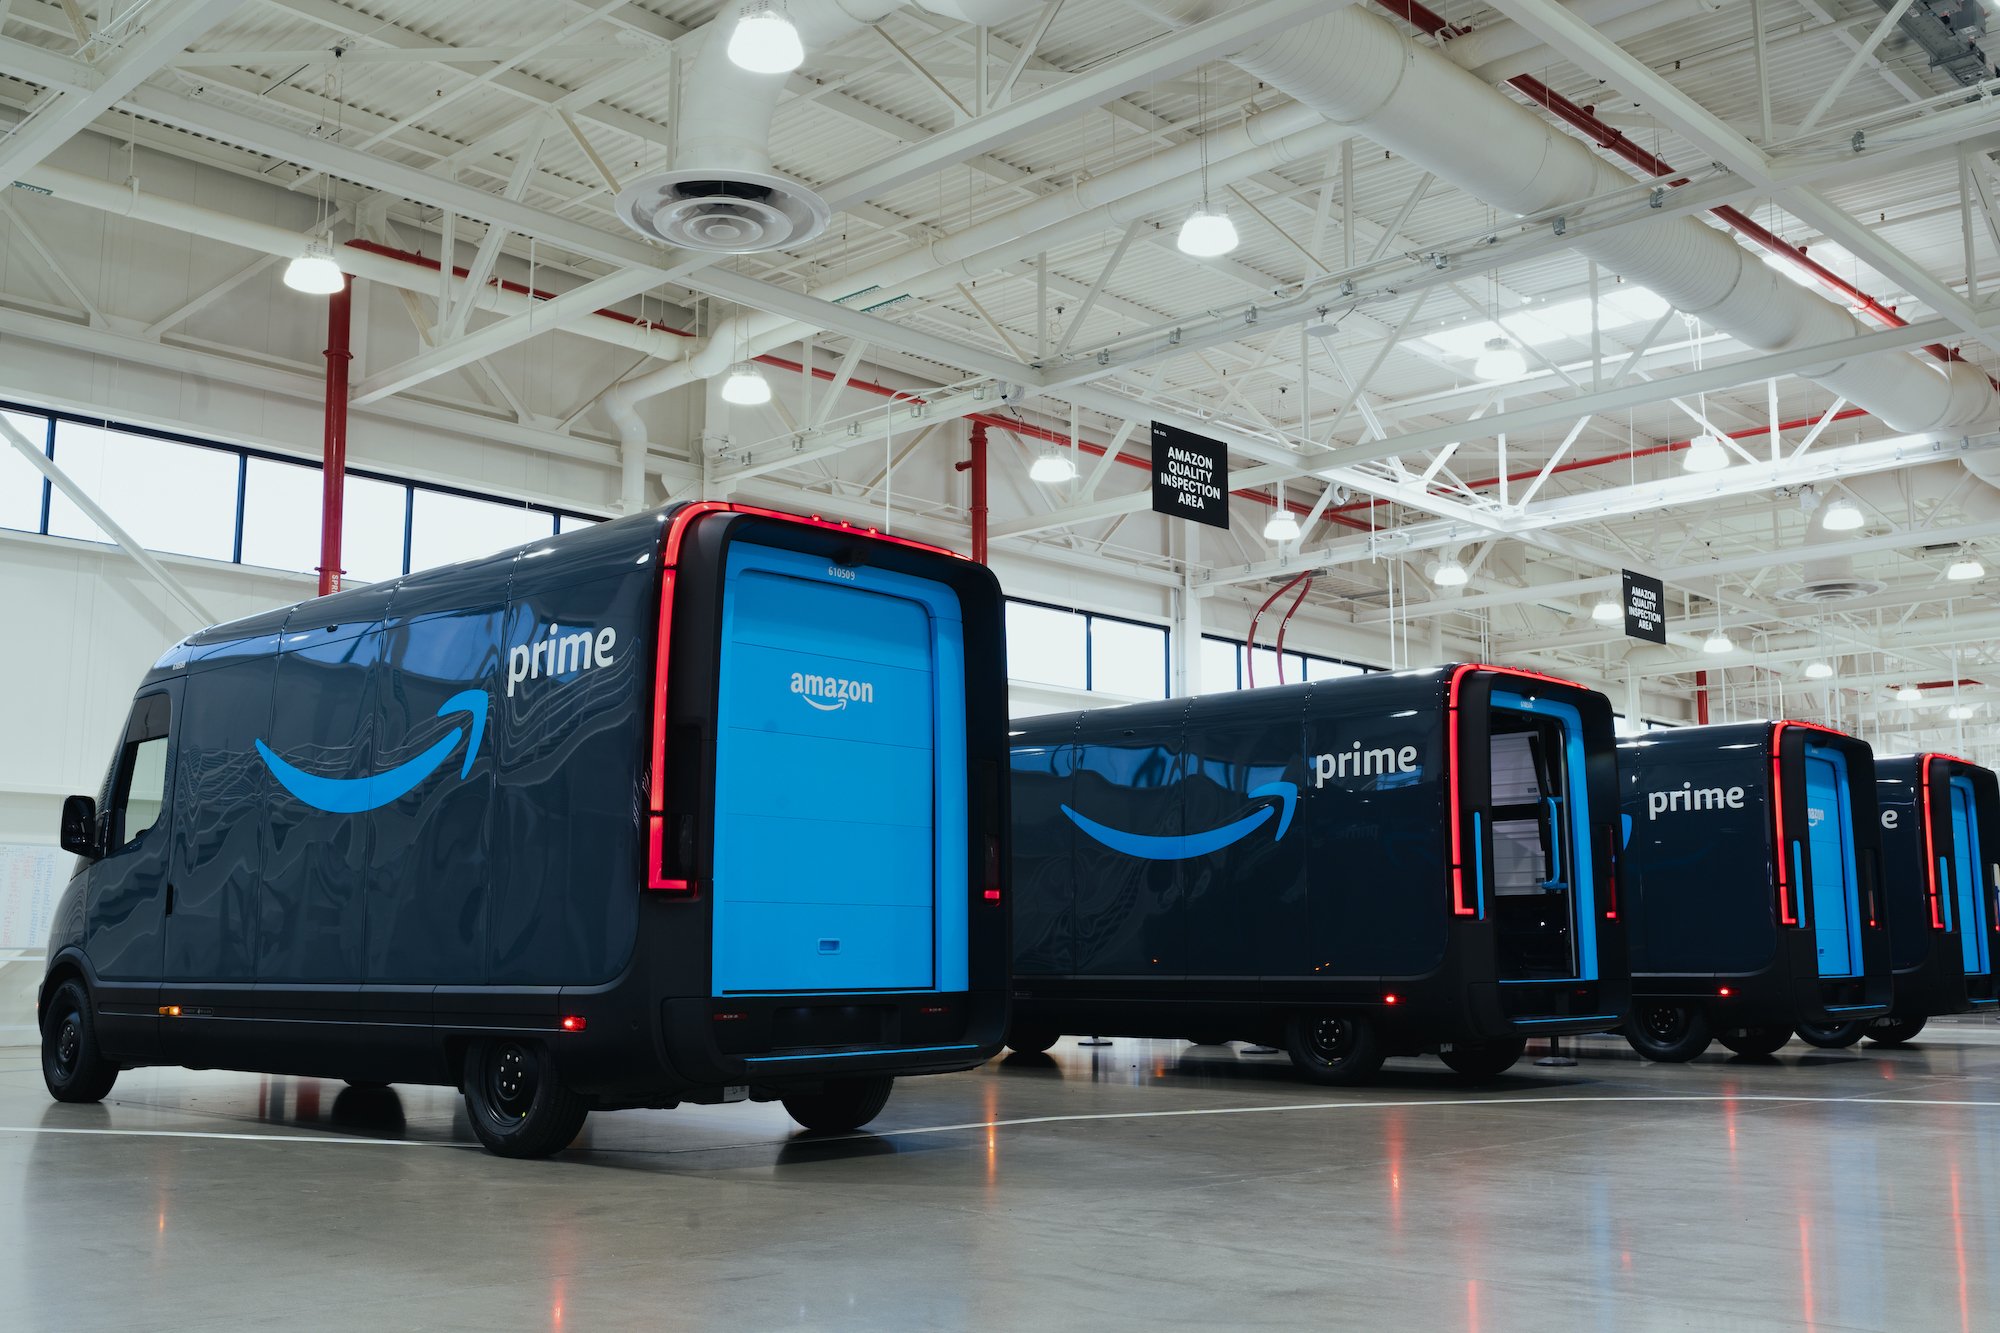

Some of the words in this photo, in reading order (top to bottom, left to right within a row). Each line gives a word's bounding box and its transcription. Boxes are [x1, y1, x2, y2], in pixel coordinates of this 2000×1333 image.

[1167, 446, 1213, 470] AMAZON
[1168, 461, 1212, 484] QUALITY
[1160, 472, 1221, 500] INSPECTION
[1178, 492, 1205, 510] AREA
[828, 566, 856, 581] 610509
[1631, 586, 1657, 601] AMAZON
[1632, 597, 1657, 611] QUALITY
[1628, 606, 1662, 623] INSPECTION
[1638, 620, 1653, 631] AREA
[507, 622, 617, 698] prime
[790, 671, 873, 704] amazon
[1316, 740, 1417, 789] prime
[1648, 781, 1745, 821] prime
